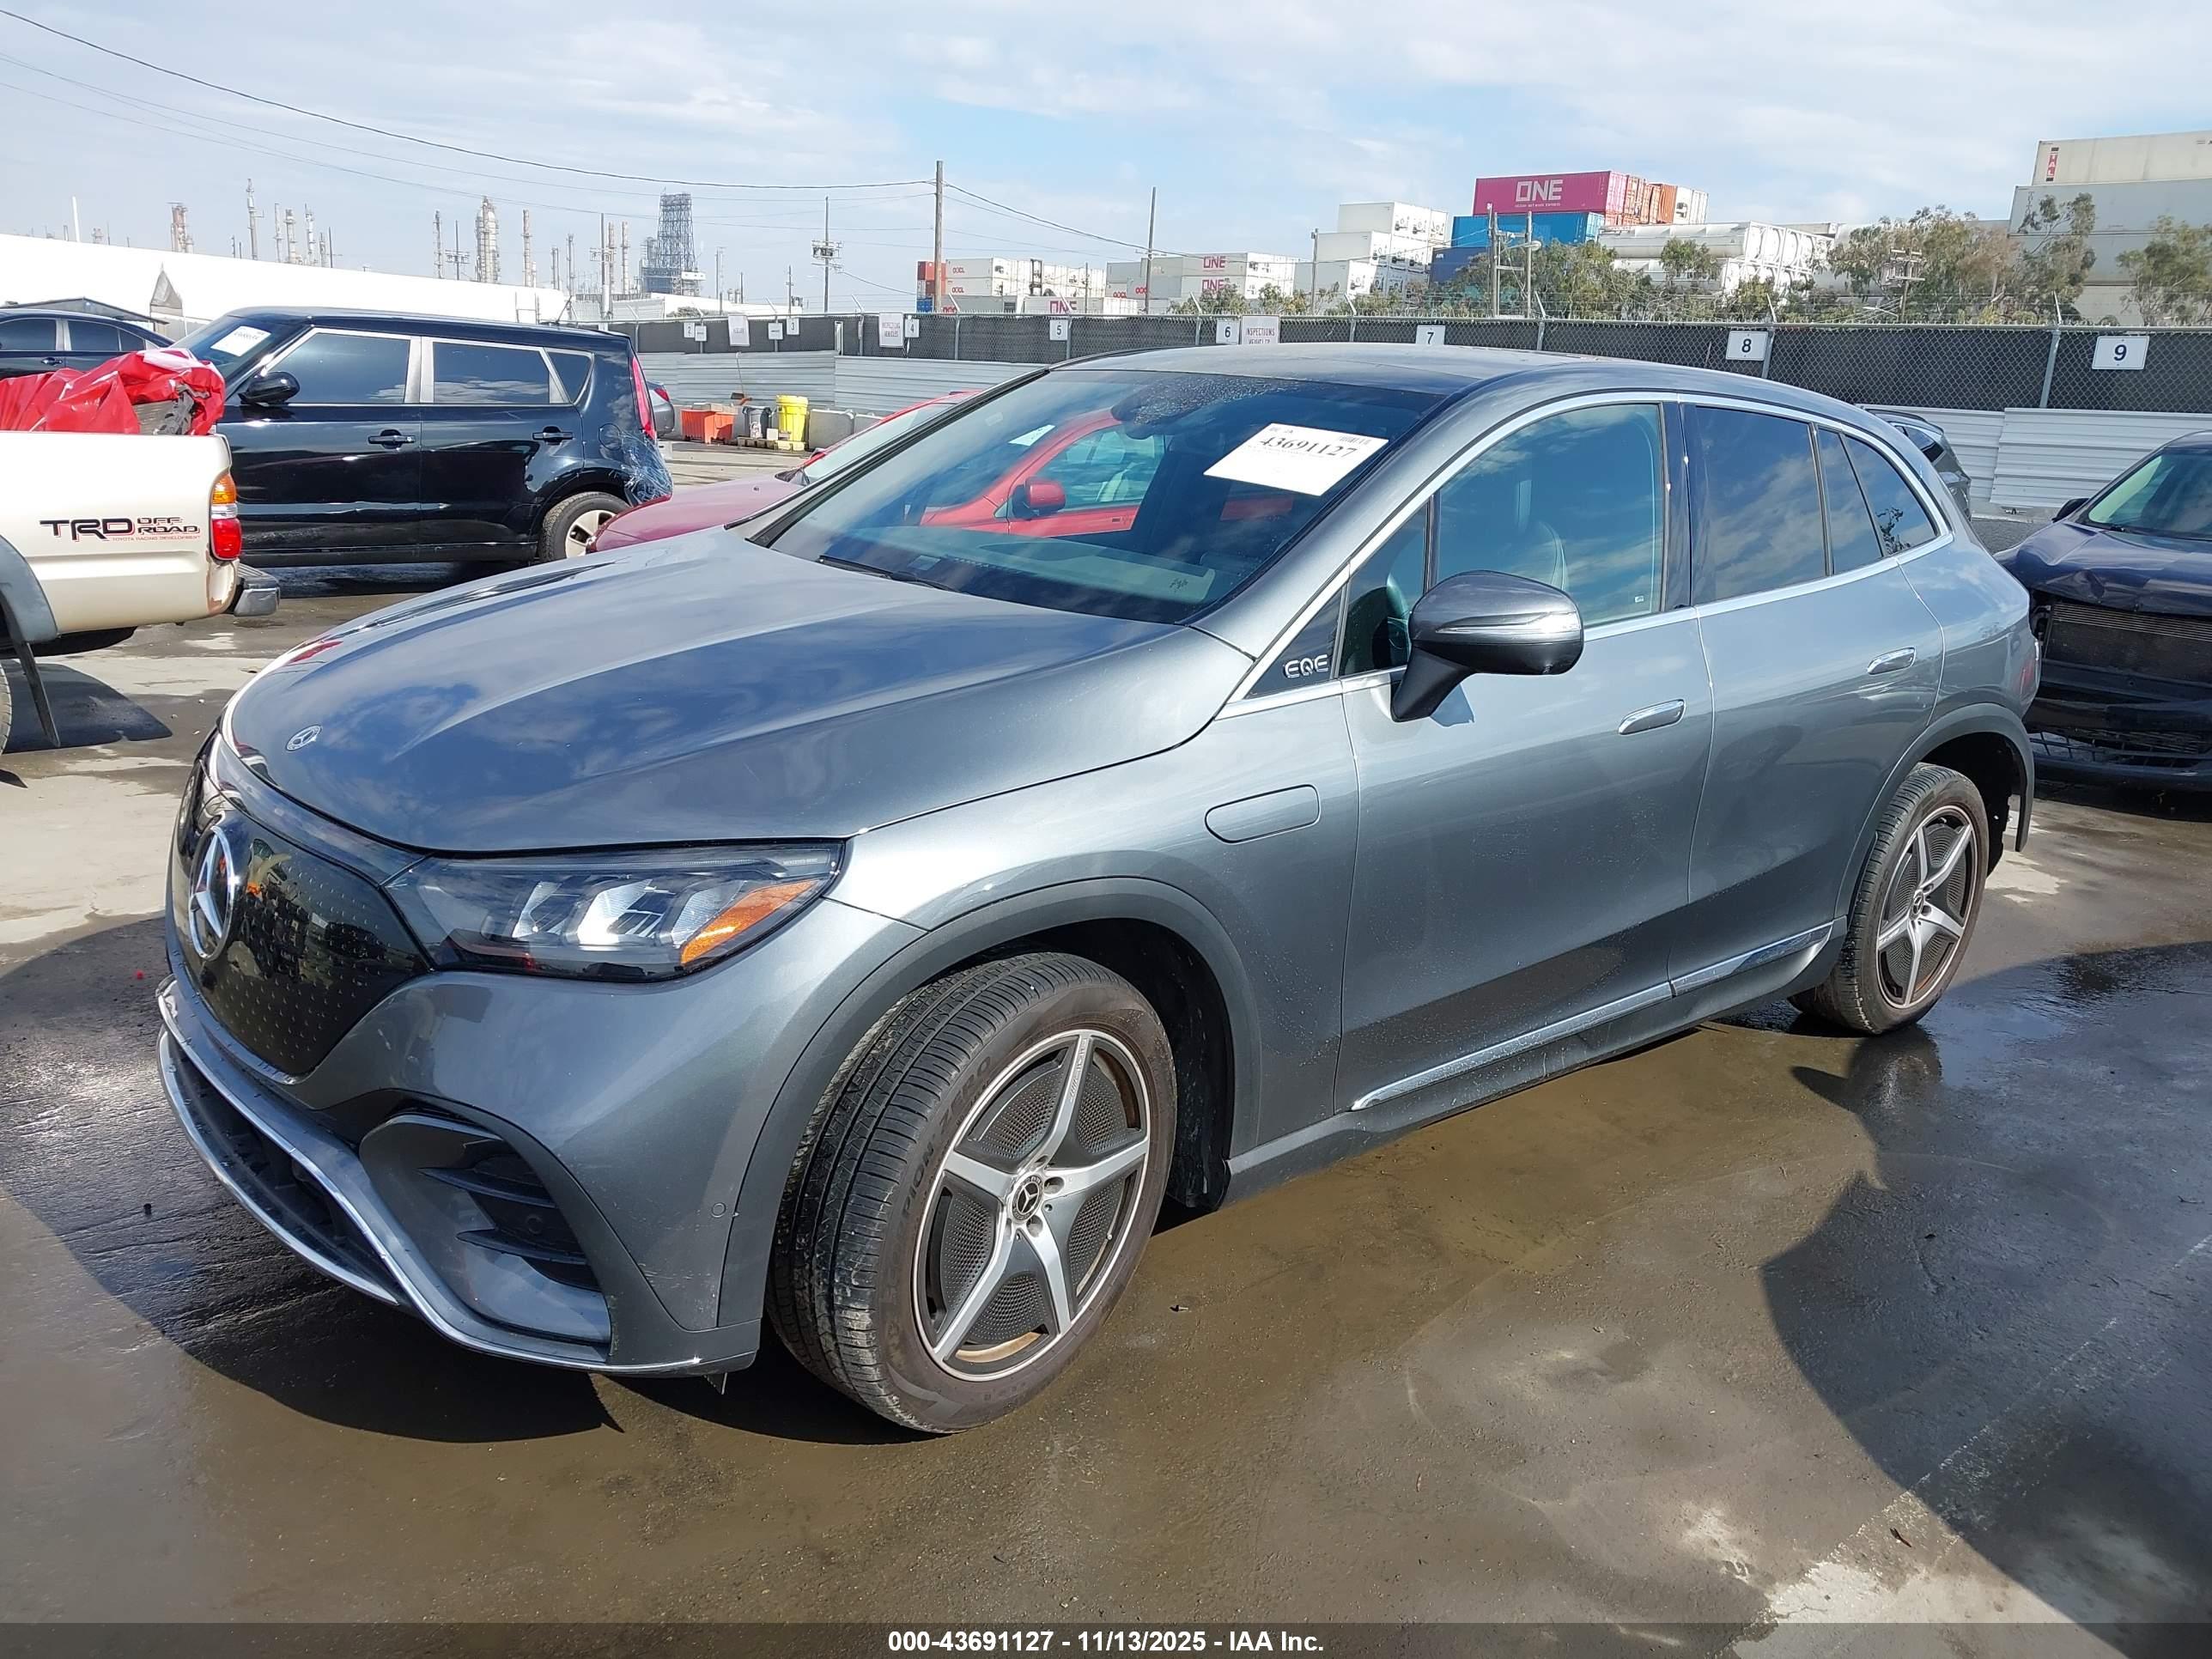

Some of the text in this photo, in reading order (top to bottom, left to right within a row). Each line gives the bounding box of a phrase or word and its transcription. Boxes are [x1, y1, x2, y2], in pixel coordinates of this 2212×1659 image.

[1516, 179, 1563, 202] ONE
[1203, 256, 1226, 268] ONE
[1202, 279, 1224, 290] ONE
[791, 322, 795, 331] 3
[910, 324, 915, 333] 4
[1056, 325, 1061, 335] 5
[1224, 326, 1231, 337] 6
[1427, 331, 1434, 344] 7
[1741, 338, 1752, 353] 8
[2113, 344, 2127, 361] 9
[1259, 436, 1358, 457] 43691127
[40, 518, 134, 542] TRD
[137, 525, 200, 534] ROAD
[1284, 653, 1328, 678] EQE
